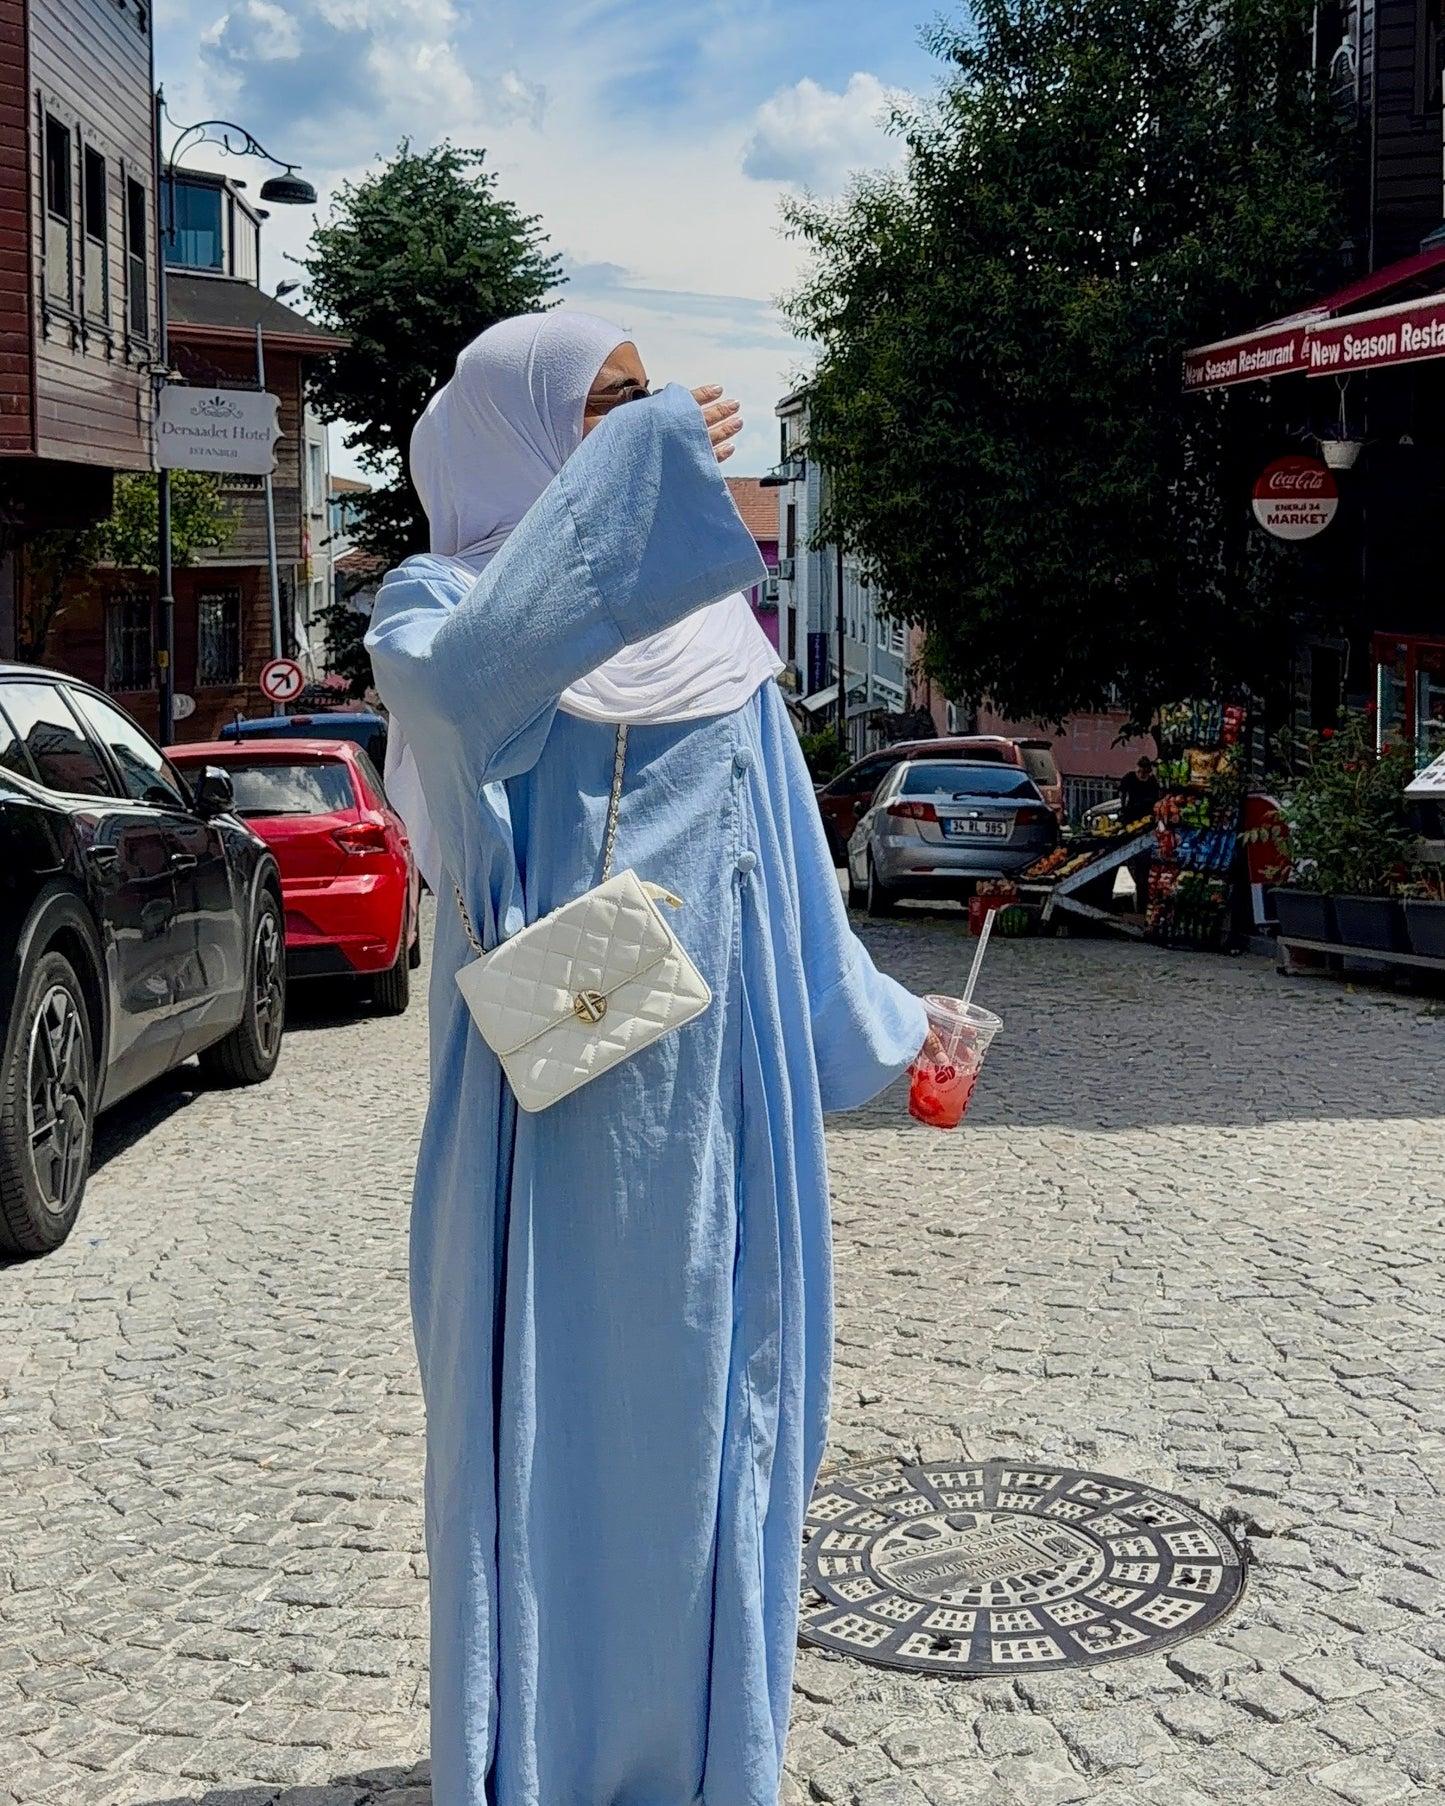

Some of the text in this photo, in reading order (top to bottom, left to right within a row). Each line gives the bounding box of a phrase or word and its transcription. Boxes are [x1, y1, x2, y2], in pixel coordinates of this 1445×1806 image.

[1310, 340, 1340, 367] New
[1343, 333, 1397, 362] Season
[1185, 364, 1204, 385] New
[1205, 360, 1237, 381] Season
[1239, 339, 1295, 374] Restaurant
[161, 421, 271, 441] Dersaadet Hotel
[1308, 503, 1320, 511] 34
[1267, 513, 1328, 525] MARKET
[953, 820, 964, 831] 34
